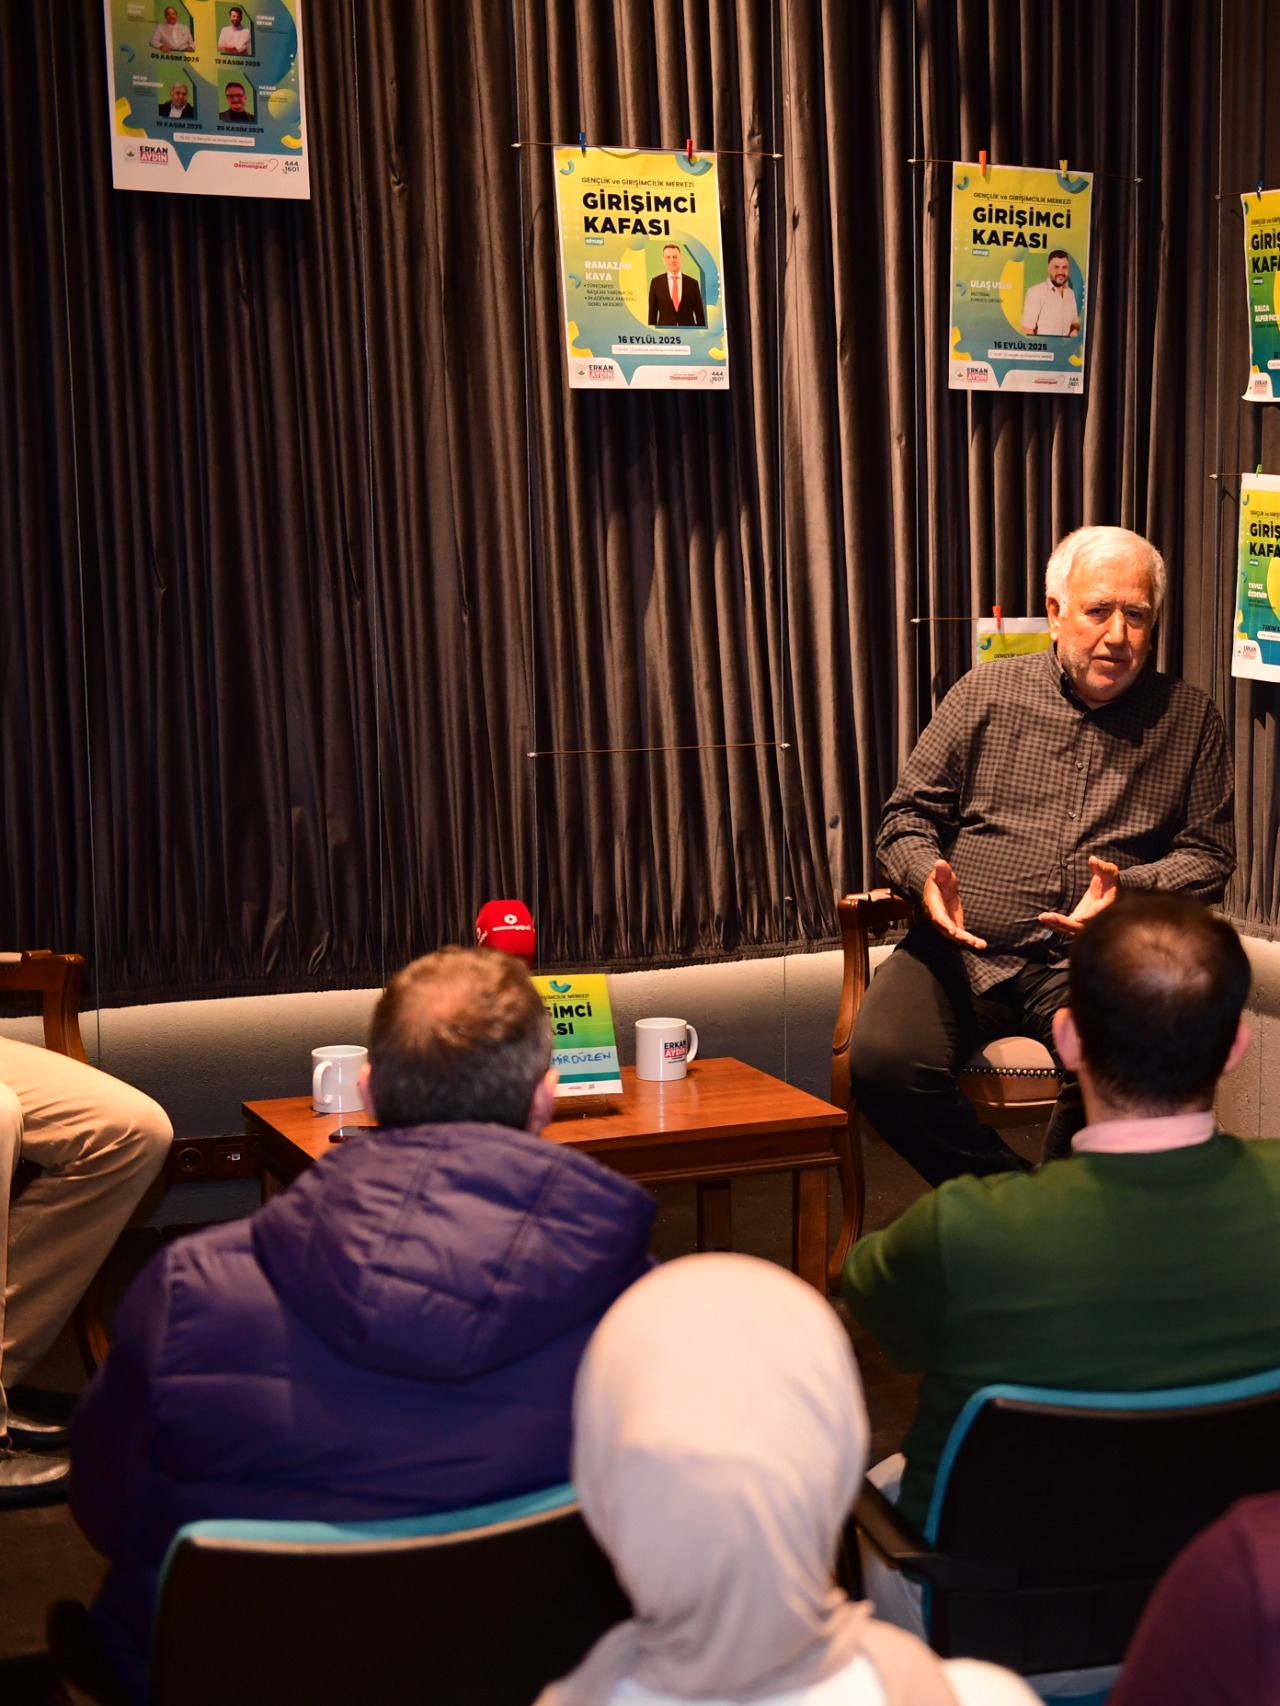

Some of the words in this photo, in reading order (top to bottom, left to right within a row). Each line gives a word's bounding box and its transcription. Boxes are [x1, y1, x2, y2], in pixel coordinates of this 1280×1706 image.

[160, 54, 182, 62] KASIM
[245, 60, 260, 68] 2025
[140, 146, 168, 154] ERKAN
[581, 176, 611, 186] GENÇLİK
[621, 179, 664, 188] GİRİŞİMCİLİK
[582, 188, 696, 215] GİRİŞİMCİ
[974, 192, 1000, 200] GENÇLİK
[1008, 195, 1046, 204] GİRİŞİMCİLİK
[972, 204, 1072, 229] GİRİŞİMCİ
[584, 216, 670, 236] KAFASI
[972, 228, 1048, 249] KAFASI
[584, 260, 632, 270] RAMAZAN
[586, 272, 613, 282] KAYA
[970, 280, 991, 292] ULAŞ
[618, 335, 628, 344] 16
[629, 334, 658, 344] EYLÜL
[658, 336, 682, 345] 2025
[994, 341, 1002, 349] 16
[1004, 341, 1027, 350] EYLÜL
[1028, 342, 1048, 351] 2025
[664, 1040, 686, 1050] ERKAN
[551, 1052, 612, 1066] MİRDÜZEN
